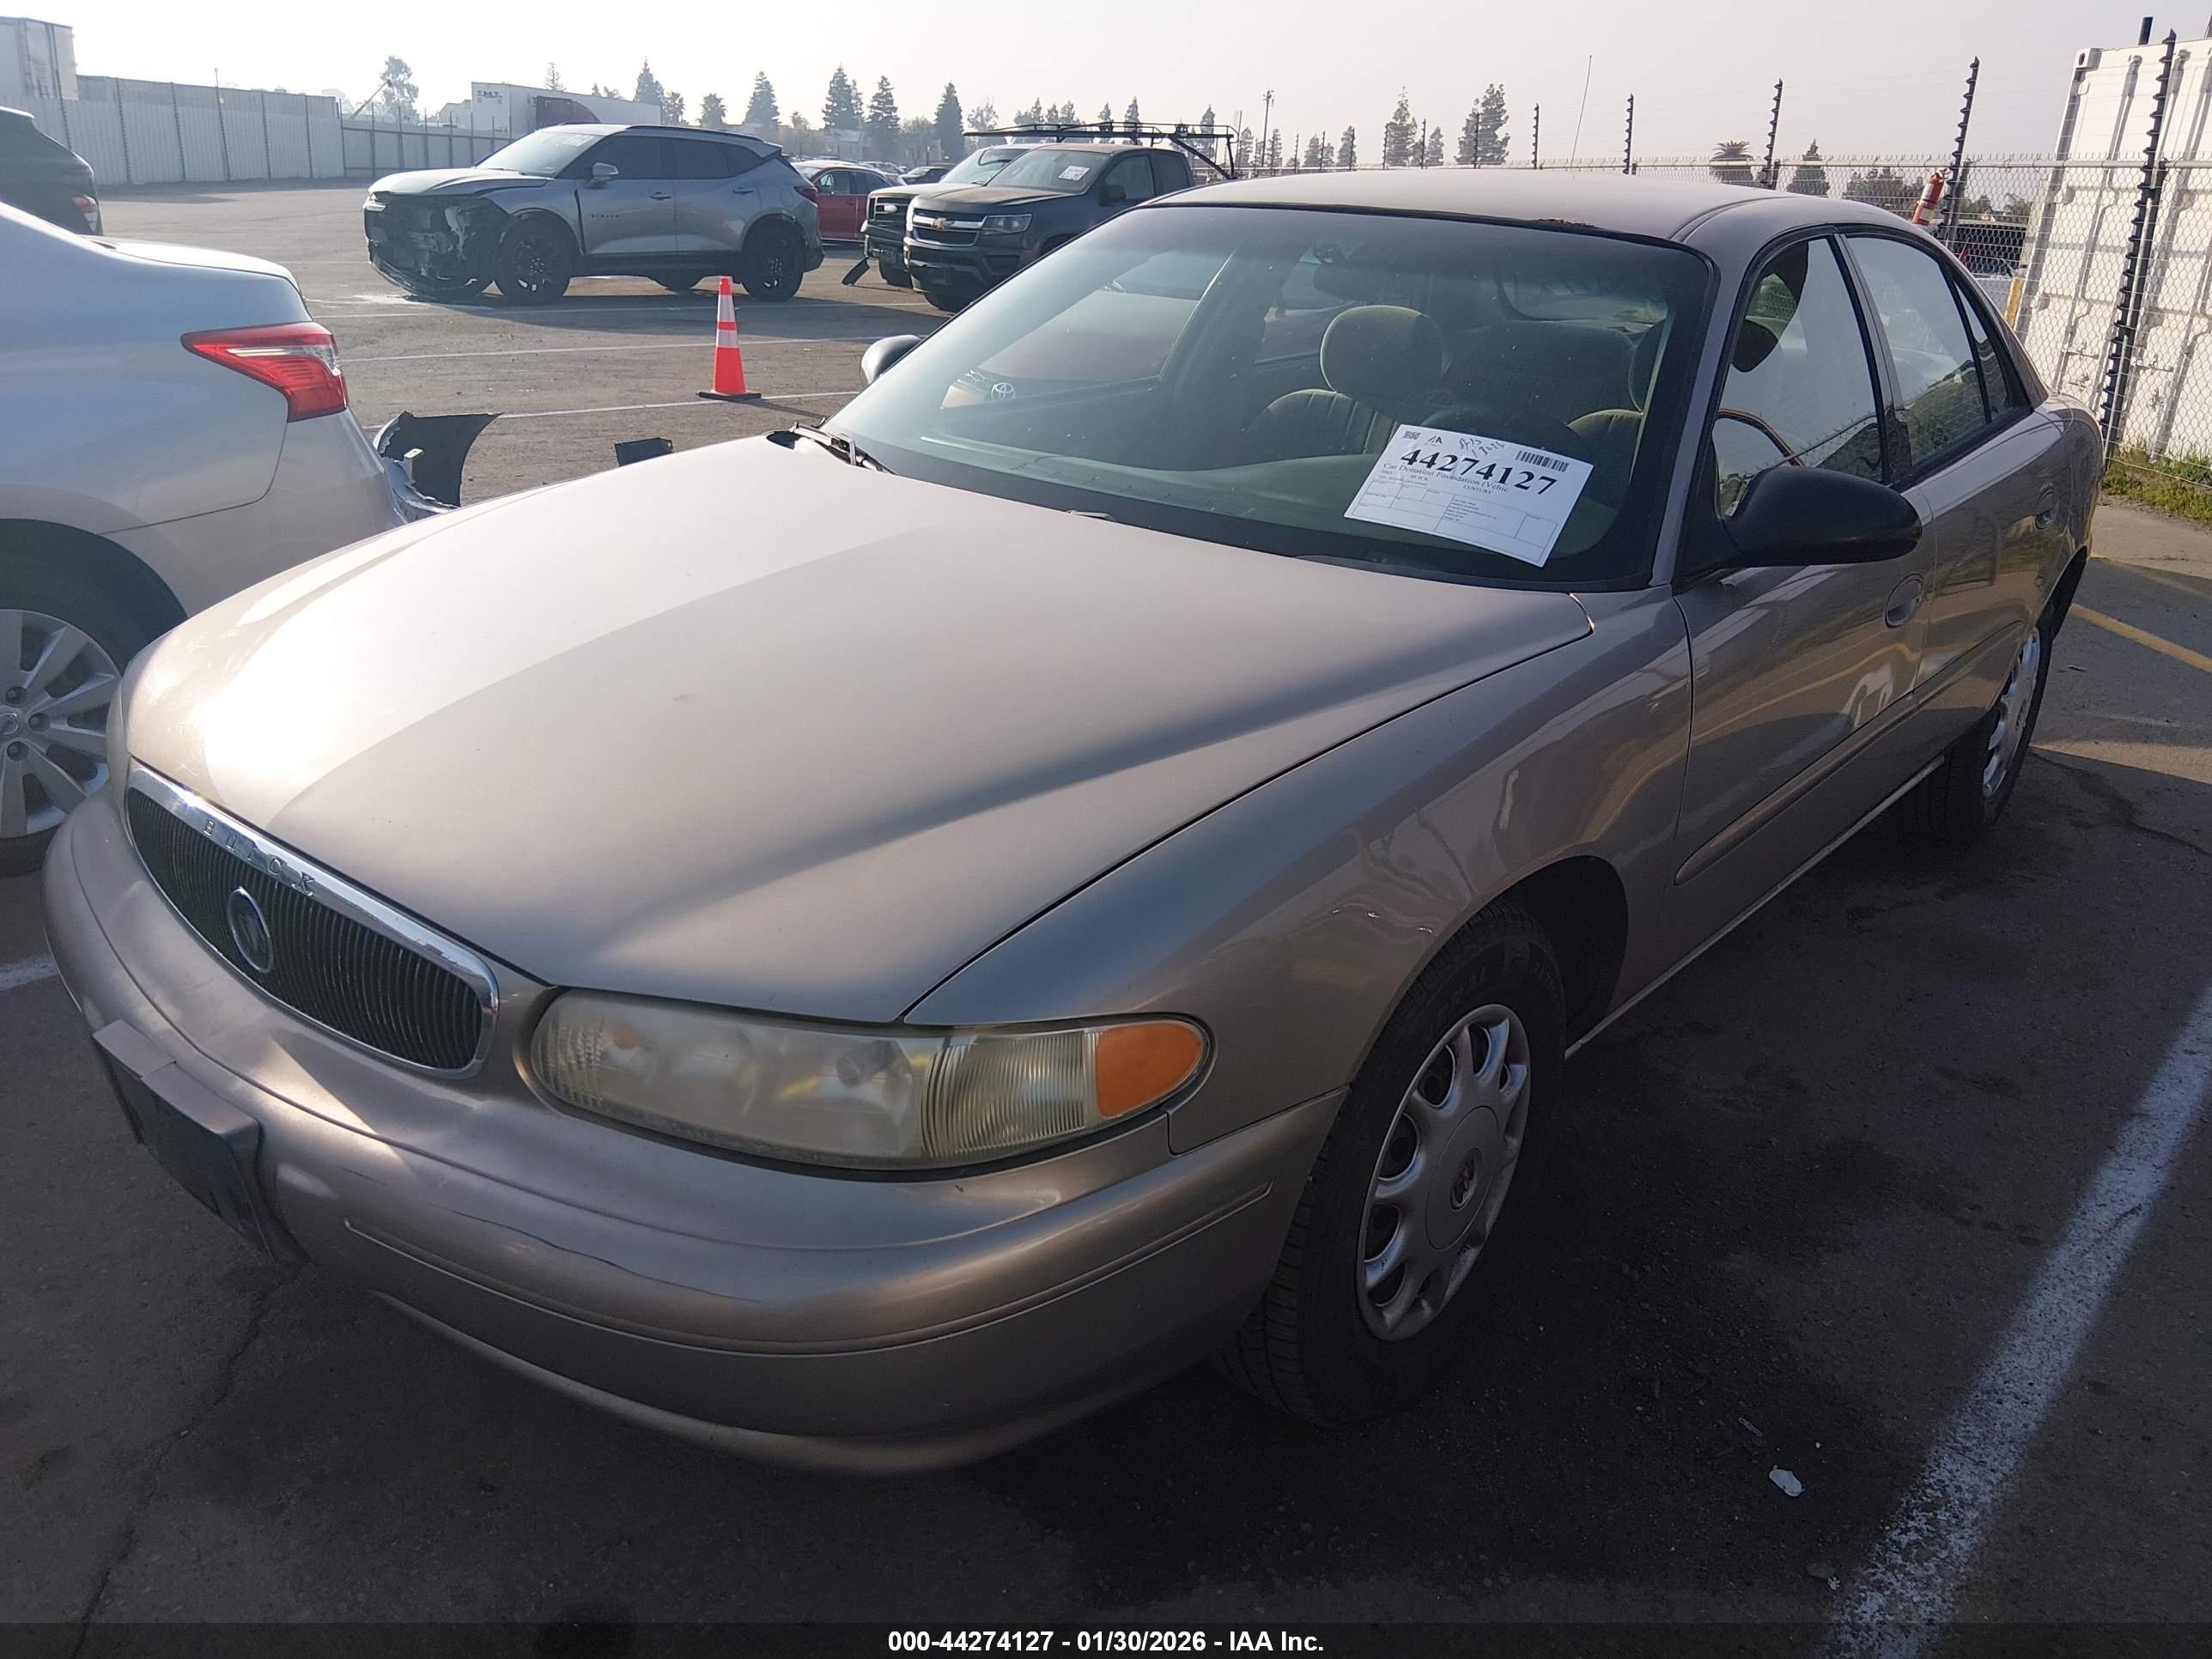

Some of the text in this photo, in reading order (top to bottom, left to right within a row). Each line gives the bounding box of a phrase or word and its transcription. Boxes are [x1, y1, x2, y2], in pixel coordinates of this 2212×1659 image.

[1400, 465, 1434, 477] Donation
[1436, 471, 1480, 486] Foundation
[1401, 449, 1559, 495] 44274127
